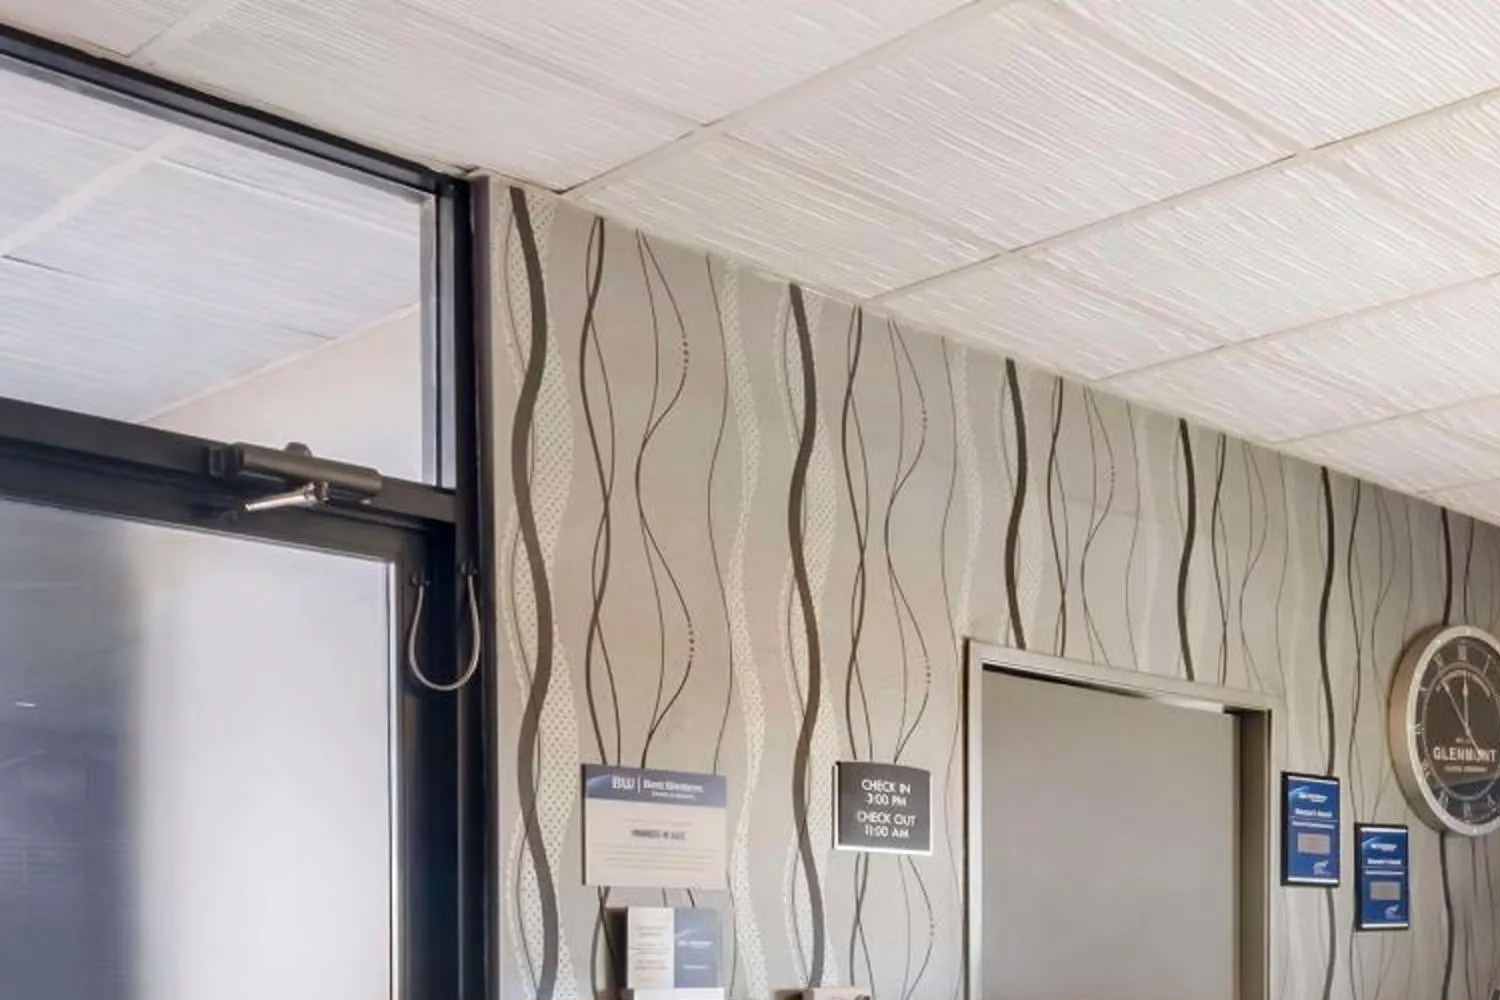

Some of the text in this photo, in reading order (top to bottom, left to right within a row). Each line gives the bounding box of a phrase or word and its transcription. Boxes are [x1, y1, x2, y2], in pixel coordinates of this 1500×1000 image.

[861, 779, 911, 795] CHECK IN
[891, 795, 907, 807] PM
[858, 810, 916, 827] CHECK OUT
[891, 827, 910, 839] AM
